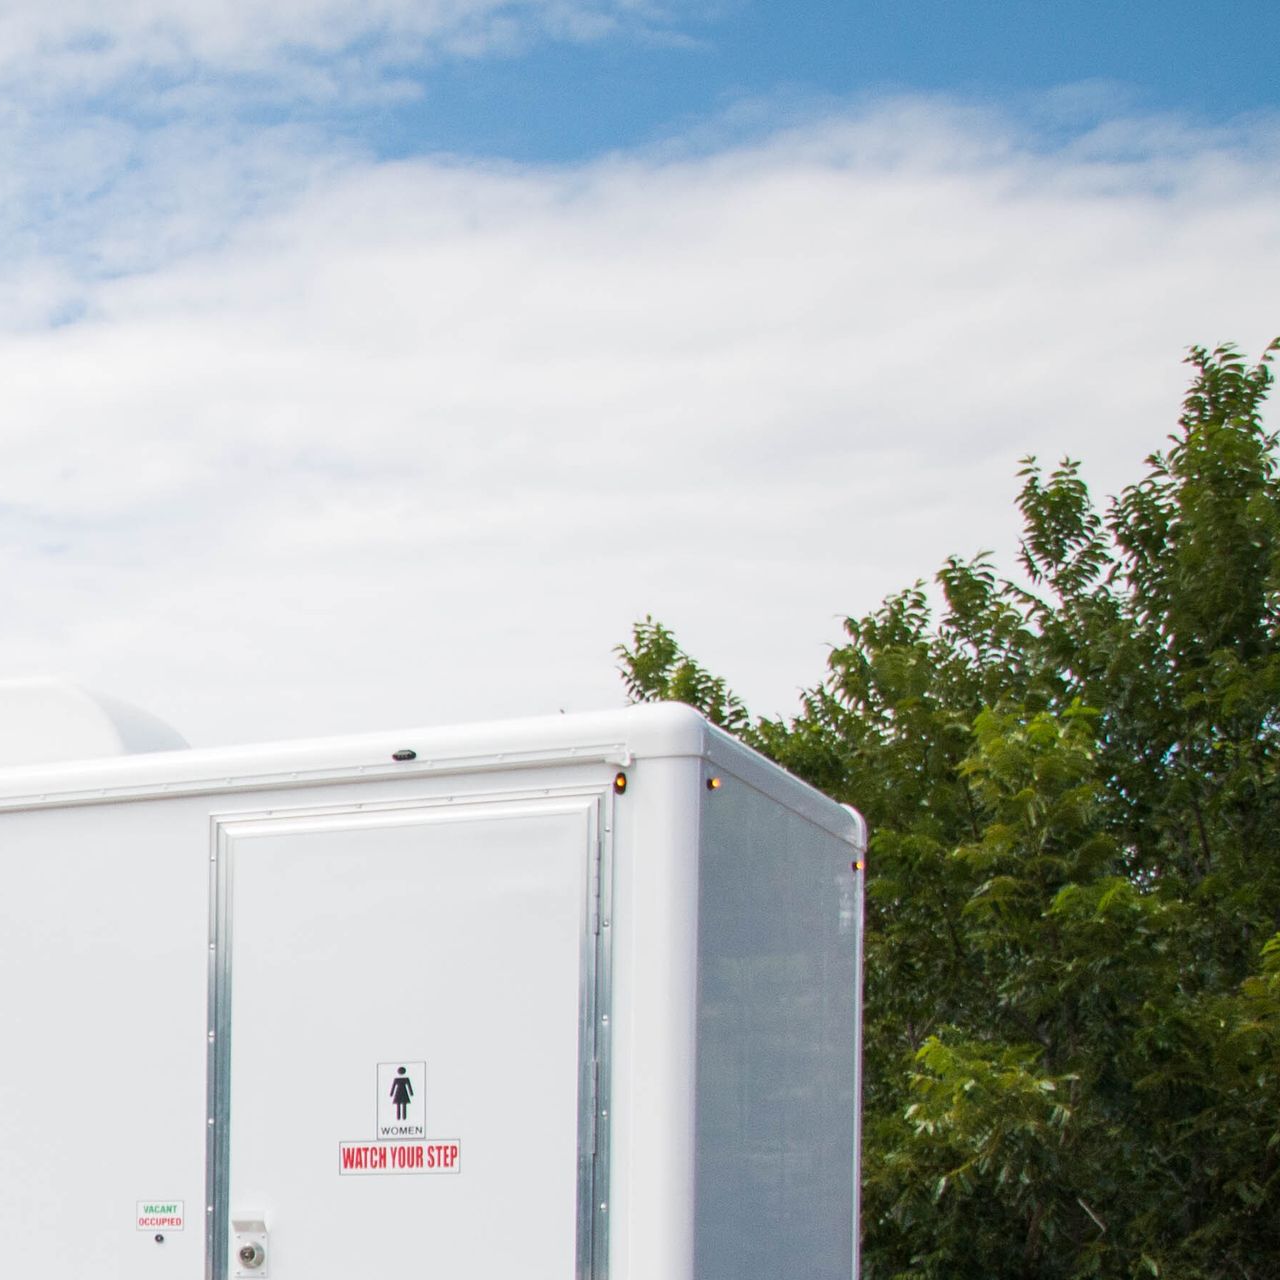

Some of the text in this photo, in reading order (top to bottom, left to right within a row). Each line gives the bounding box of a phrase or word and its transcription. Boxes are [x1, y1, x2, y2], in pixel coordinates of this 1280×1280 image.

[381, 1126, 423, 1135] WOMEN
[342, 1145, 458, 1169] WATCH YOUR STEP
[143, 1204, 177, 1214] VACANT
[138, 1217, 182, 1226] OCCUPIED
